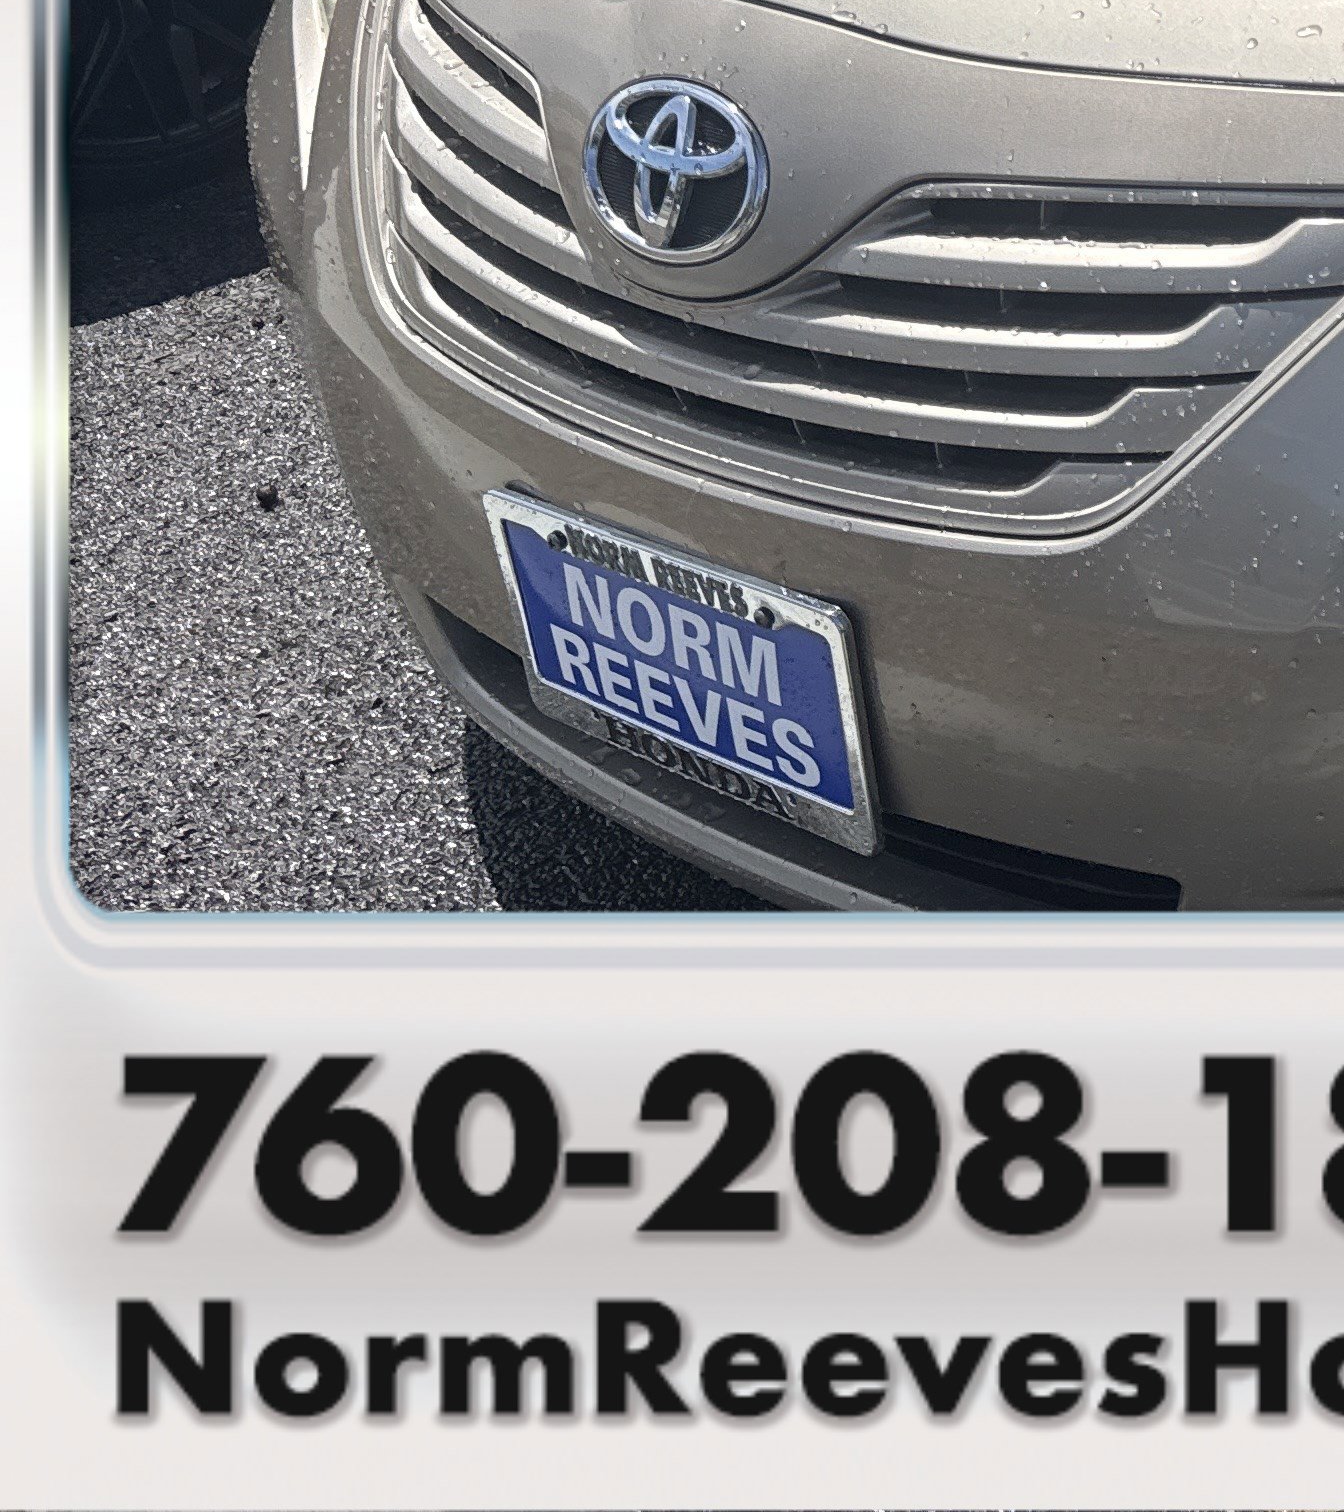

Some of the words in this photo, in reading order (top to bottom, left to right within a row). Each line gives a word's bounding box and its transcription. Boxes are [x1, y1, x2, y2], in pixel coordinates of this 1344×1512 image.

[564, 523, 648, 581] NORM
[651, 556, 749, 618] REEVES
[563, 562, 783, 707] NORM
[550, 623, 821, 788] REEVES
[604, 715, 796, 821] HONDA
